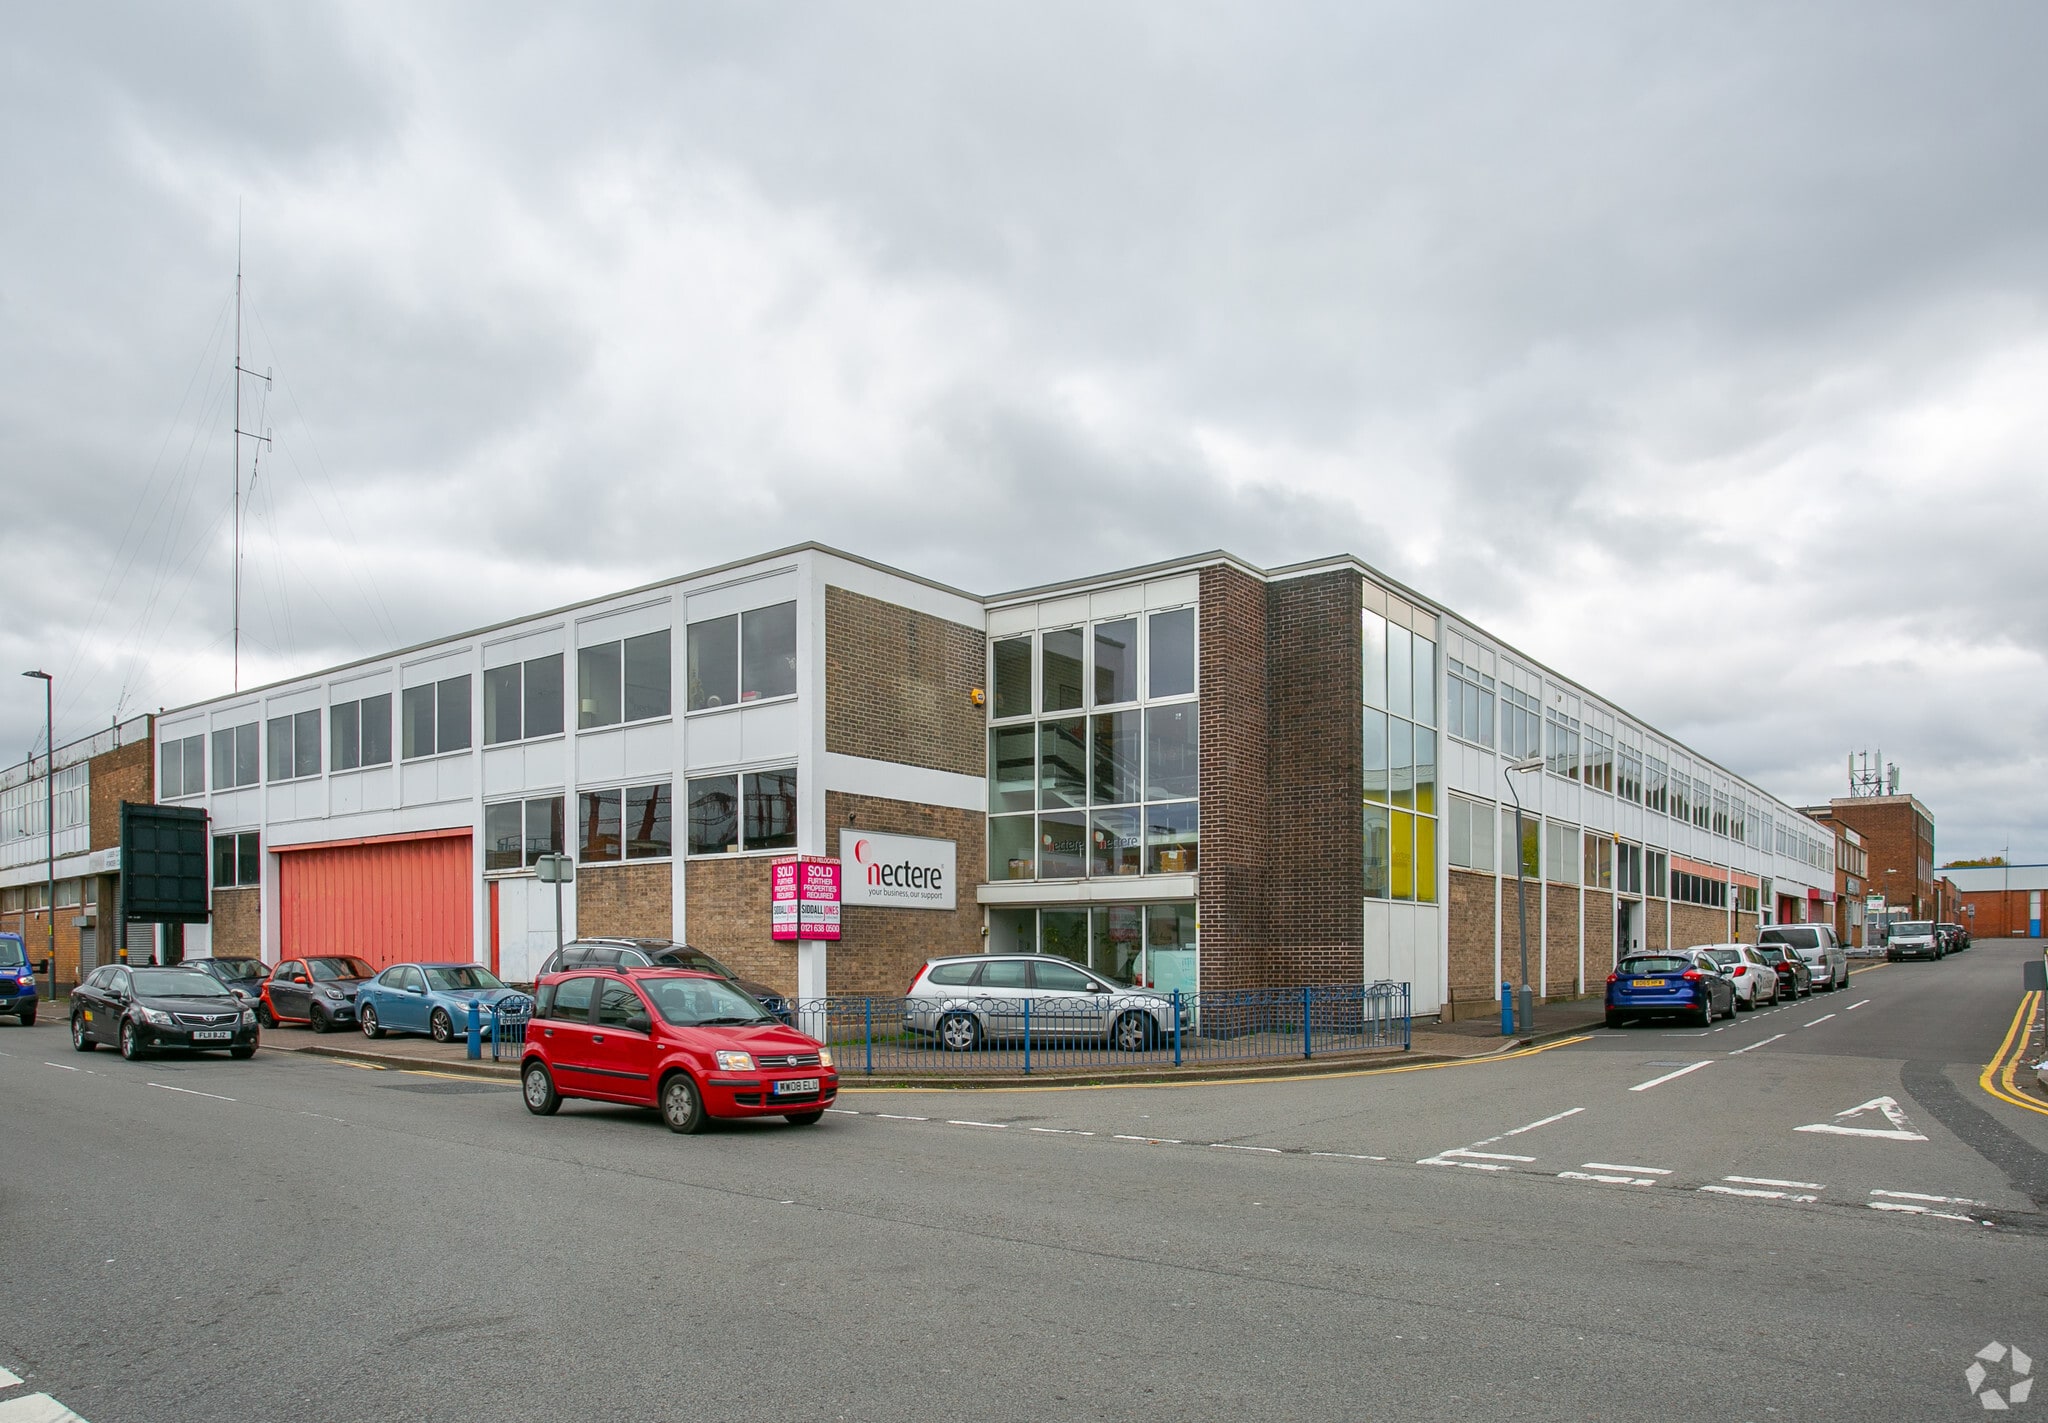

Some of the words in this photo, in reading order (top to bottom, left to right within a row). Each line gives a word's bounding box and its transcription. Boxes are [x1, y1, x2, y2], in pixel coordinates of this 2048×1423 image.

[817, 857, 841, 865] RELOCATION
[777, 866, 794, 878] SOLD
[807, 865, 833, 877] SOLD
[867, 860, 942, 890] nectere
[807, 877, 833, 885] FURTHER
[803, 884, 837, 893] PROPERTIES
[806, 891, 834, 899] REQUIRED
[868, 888, 882, 897] your
[883, 888, 910, 899] business,
[921, 891, 943, 900] support
[801, 904, 823, 915] SIDDALL
[822, 905, 839, 921] JONES
[801, 924, 813, 932] 0121
[825, 924, 840, 932] 0500
